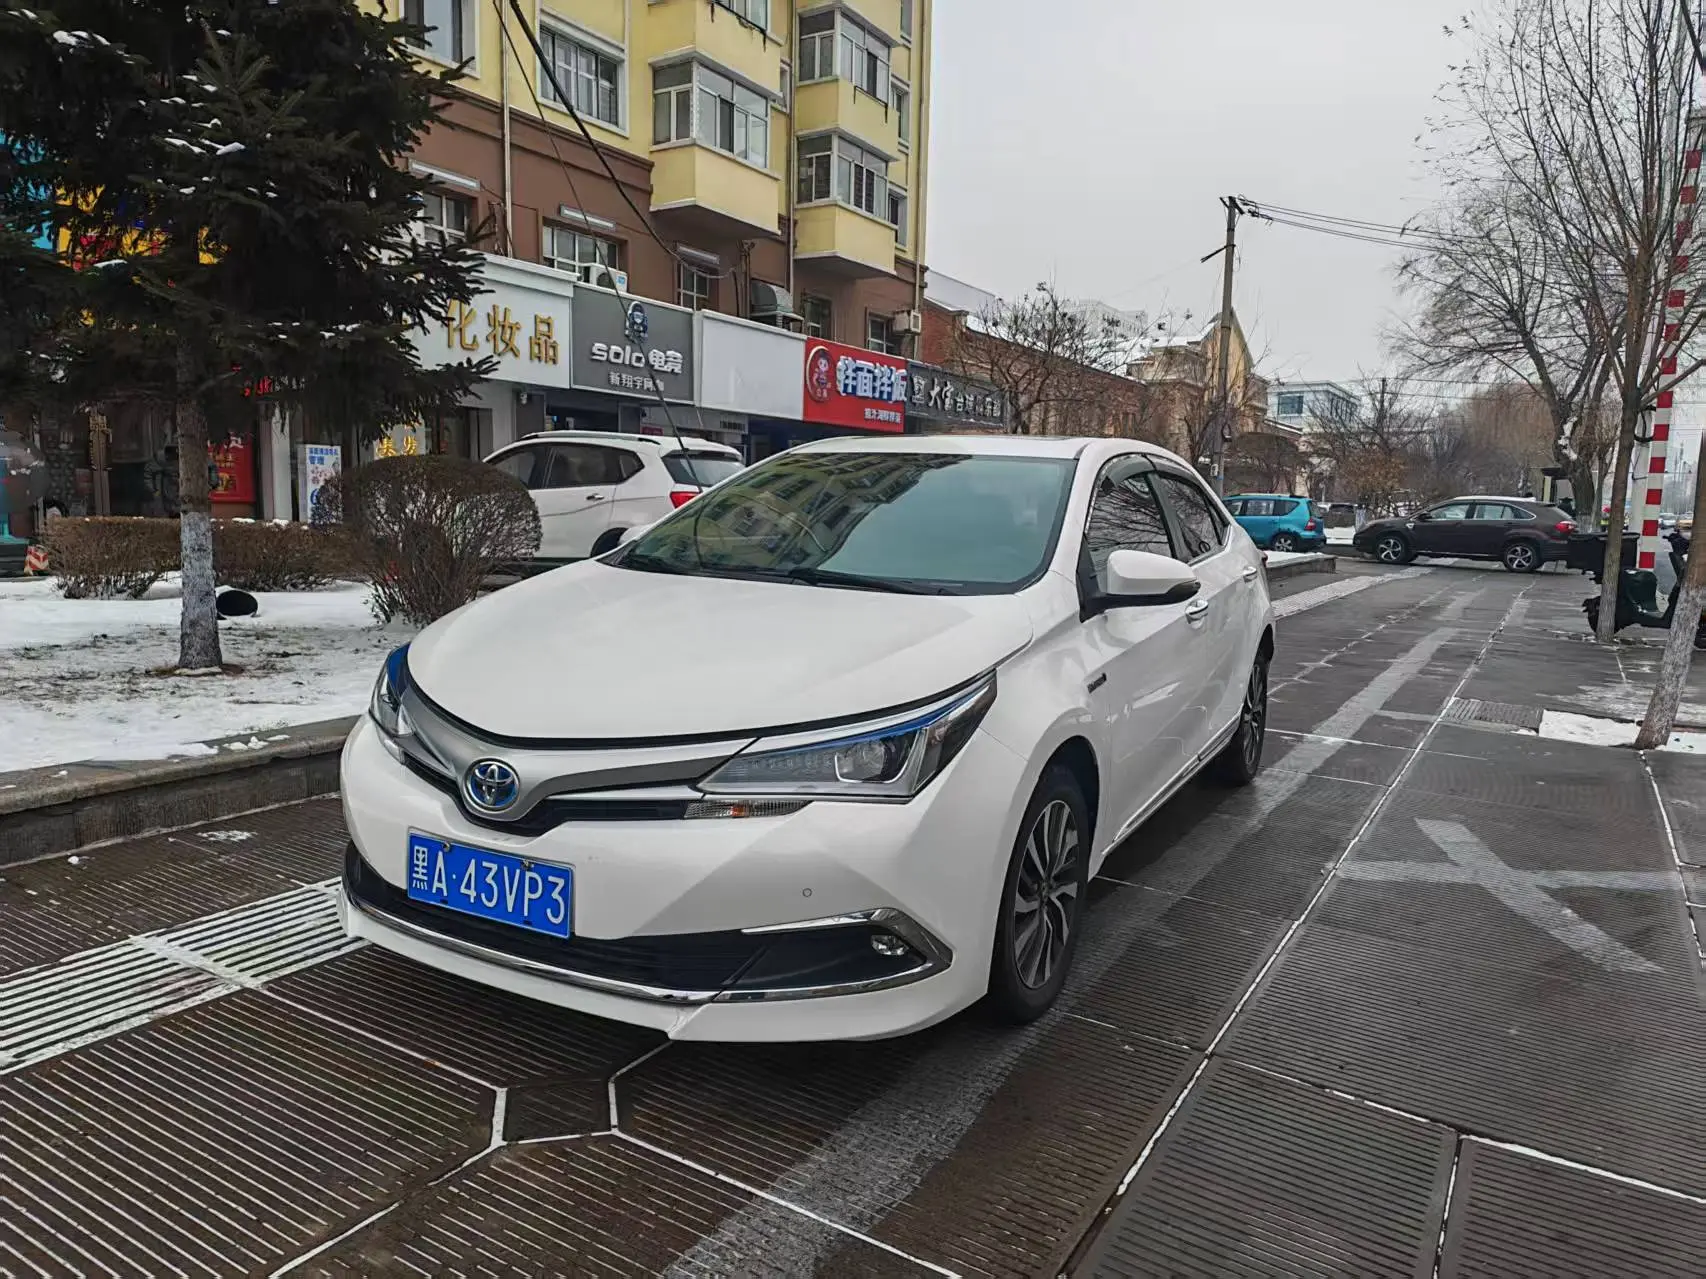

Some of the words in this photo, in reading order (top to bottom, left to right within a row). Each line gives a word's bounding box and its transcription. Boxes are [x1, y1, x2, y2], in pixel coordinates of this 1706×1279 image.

[446, 298, 560, 366] 化妆品
[591, 342, 646, 368] solo
[836, 355, 908, 404] 拌面拌饭
[411, 844, 566, 926] 黑A·43VP3
